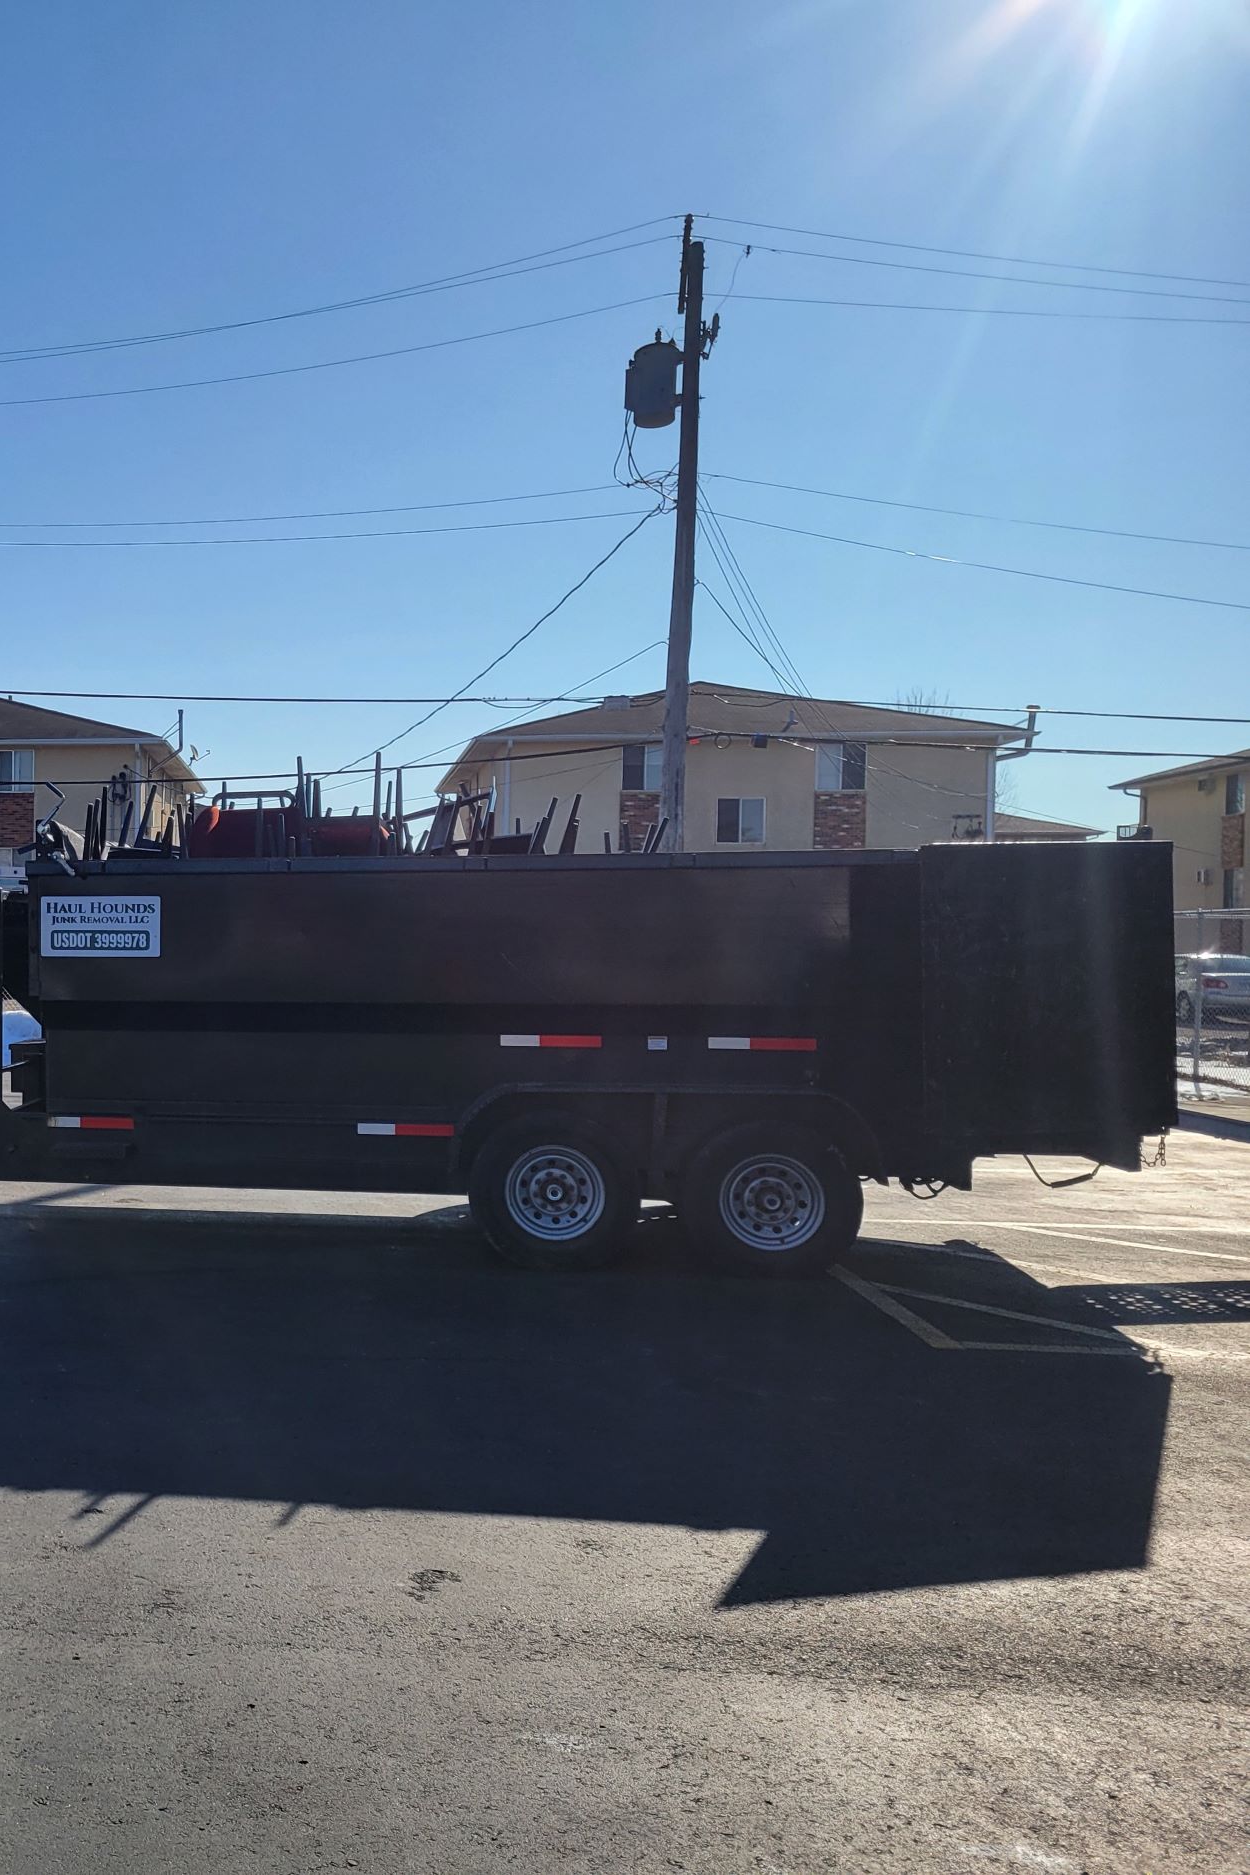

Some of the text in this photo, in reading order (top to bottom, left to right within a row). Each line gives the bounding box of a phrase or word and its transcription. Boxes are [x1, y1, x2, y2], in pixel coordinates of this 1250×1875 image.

[46, 902, 156, 915] HAUL HOUNDS
[51, 915, 150, 926] JUNK REMOVAL LLC
[53, 932, 147, 949] USDOT 3999978
